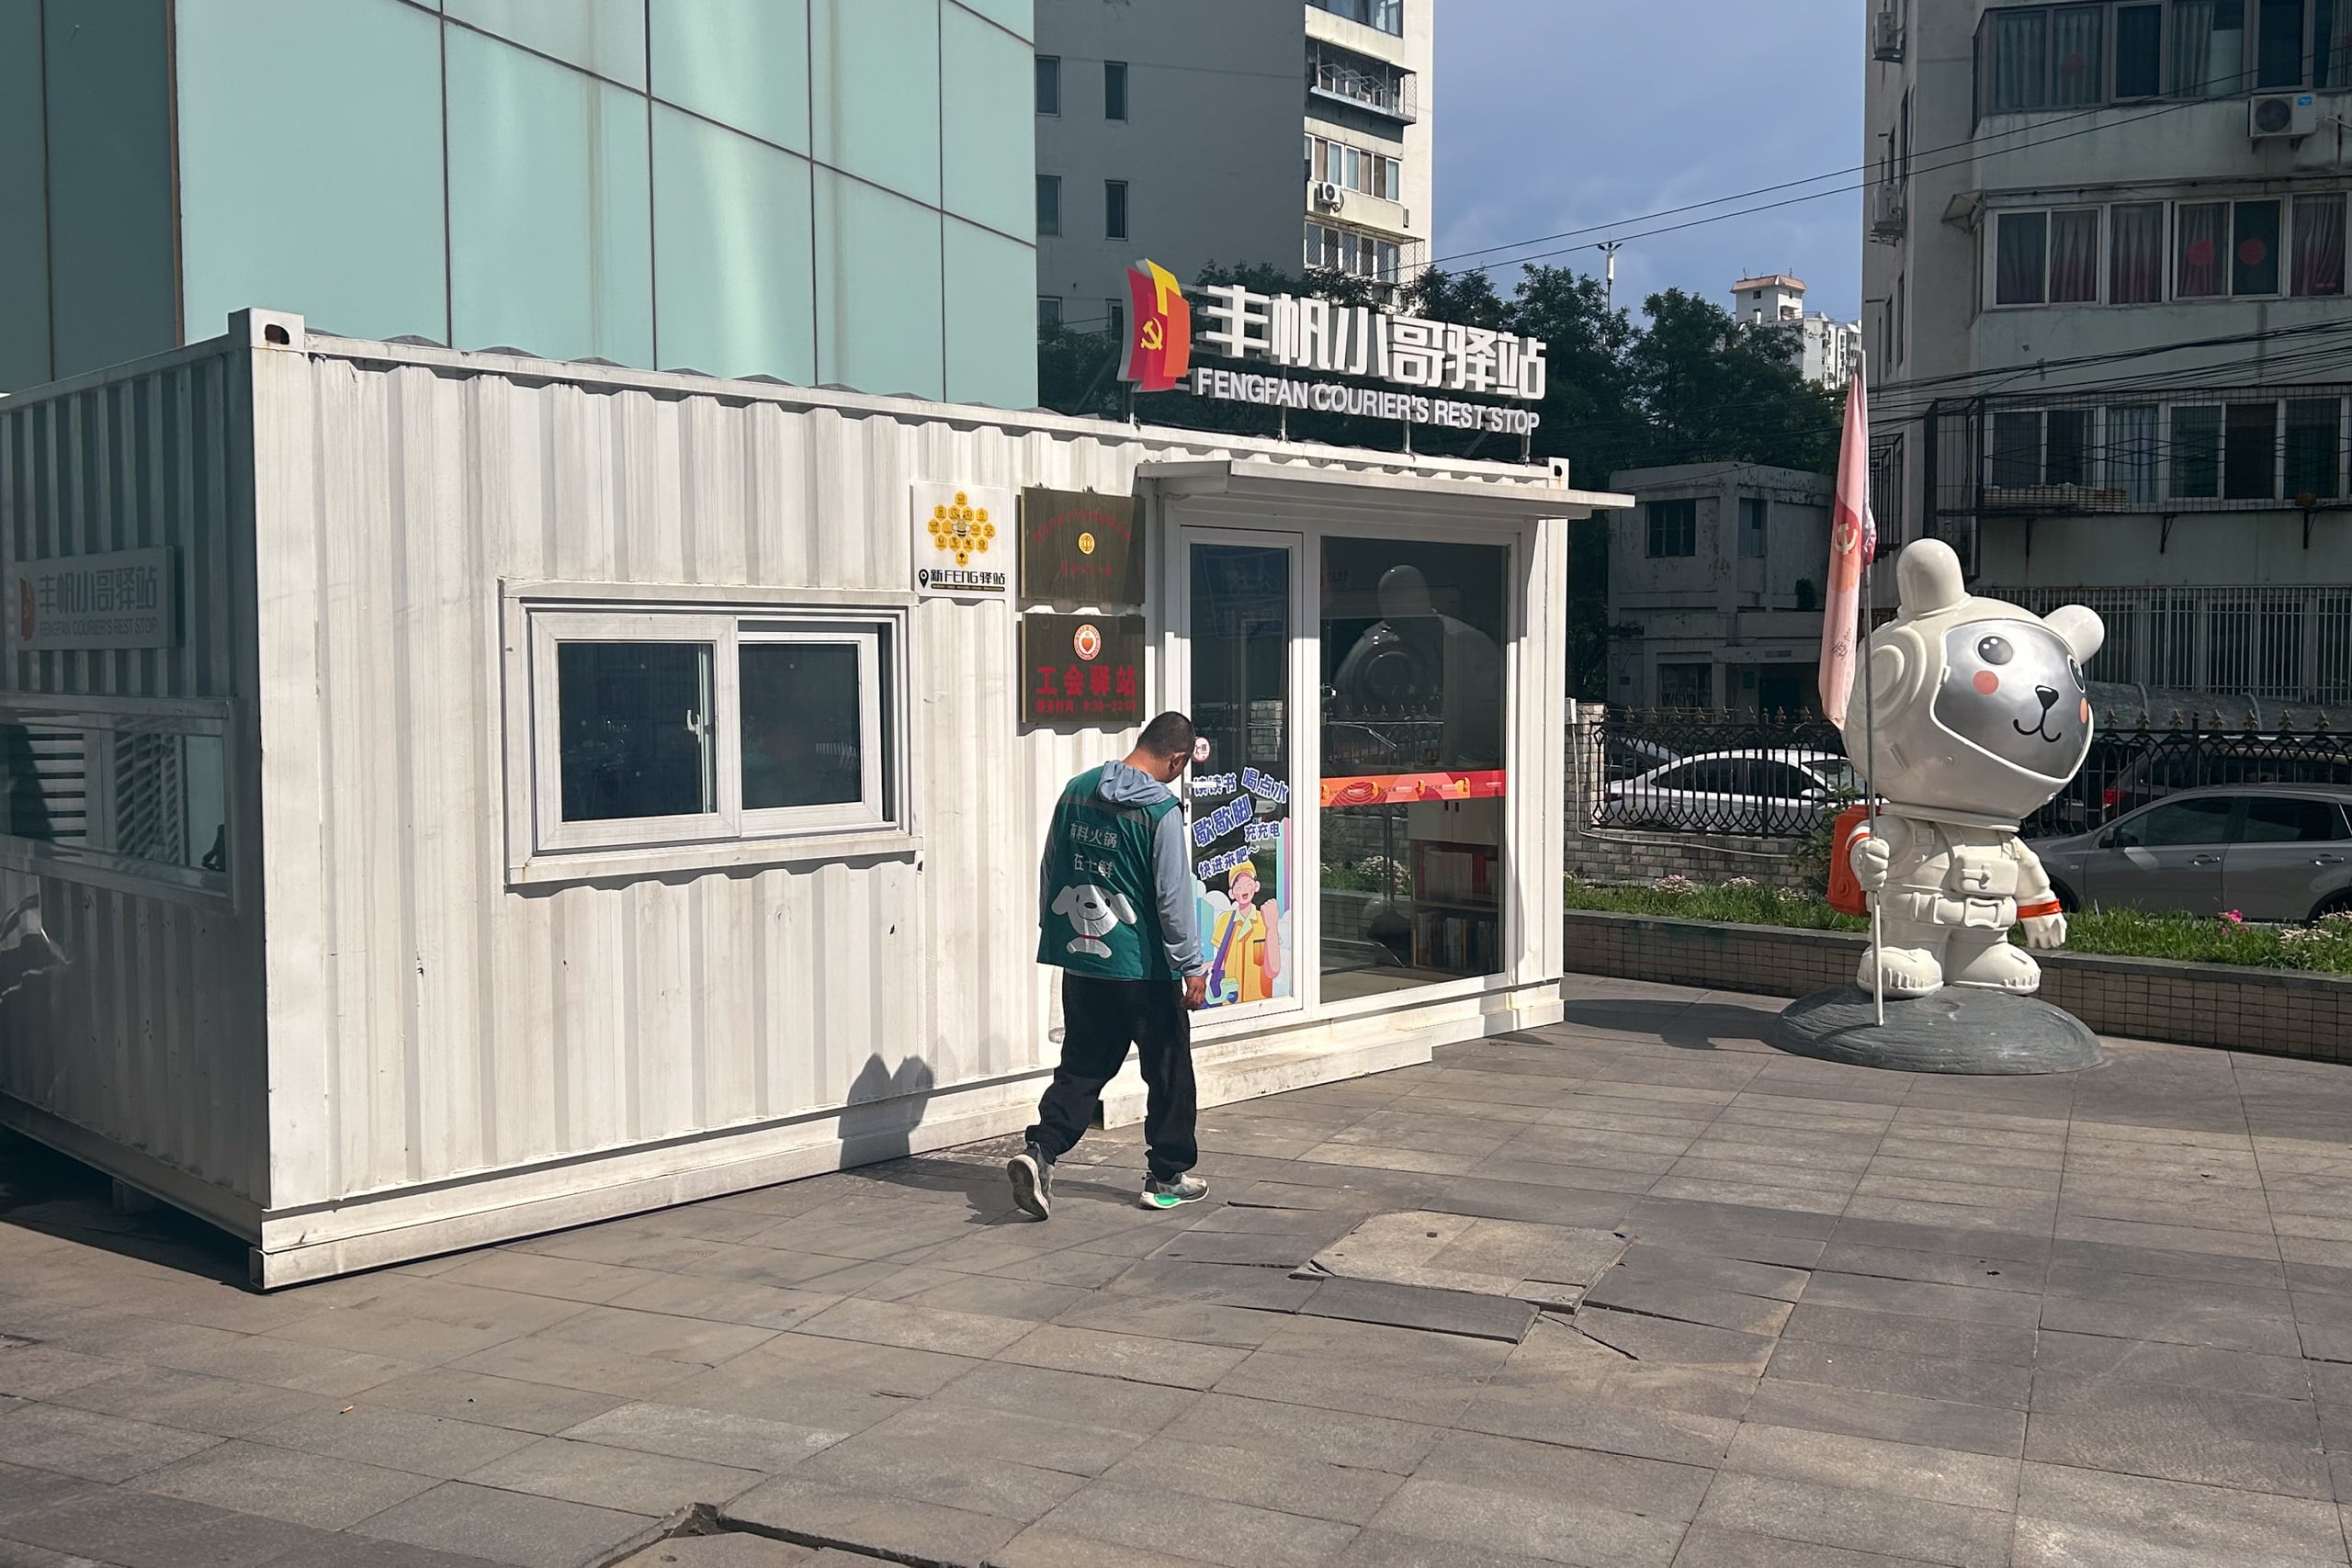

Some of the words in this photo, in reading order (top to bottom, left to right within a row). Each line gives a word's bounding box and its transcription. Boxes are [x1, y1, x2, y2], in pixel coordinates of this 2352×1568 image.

[1204, 285, 1547, 400] 丰帆小哥驿站
[1197, 367, 1308, 409] FENGFAN
[1314, 383, 1430, 423] COURIER'S
[1434, 399, 1487, 430] REST
[1490, 406, 1541, 436] STOP
[39, 566, 158, 615] 丰帆小哥驿站
[134, 617, 158, 634] STOP
[1241, 767, 1289, 804] 喝点水
[1193, 794, 1252, 846] 歇歇脚
[1244, 821, 1281, 842] 充充电
